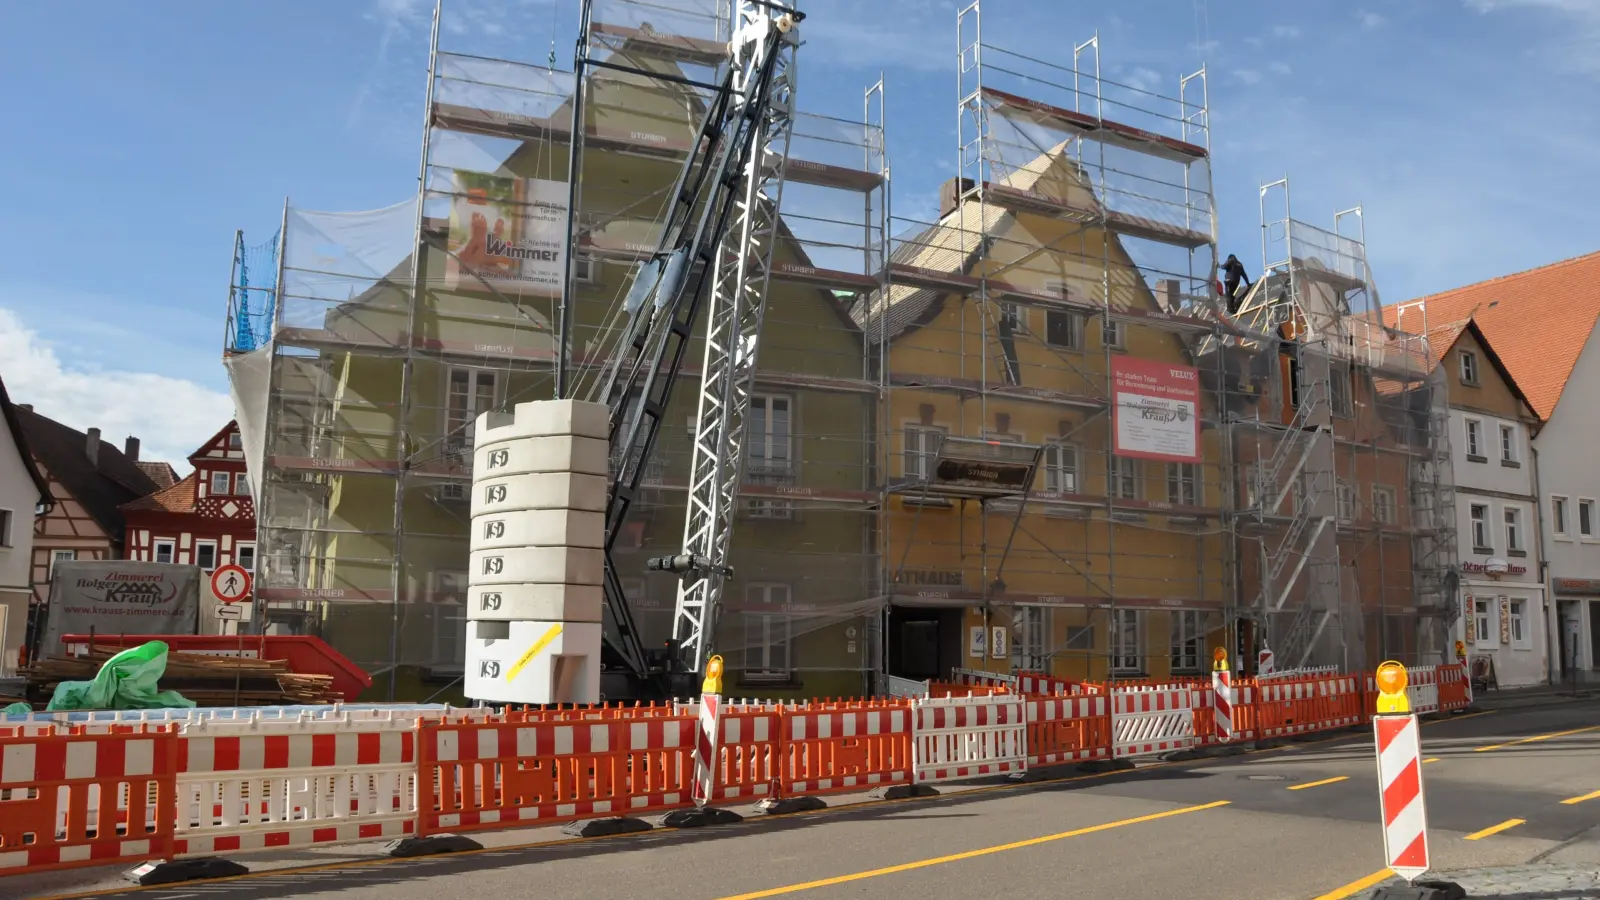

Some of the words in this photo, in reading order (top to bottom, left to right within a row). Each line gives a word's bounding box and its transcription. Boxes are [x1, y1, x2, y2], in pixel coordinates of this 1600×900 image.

[486, 232, 559, 262] Wimmer
[1169, 369, 1194, 380] VELUX
[489, 449, 509, 469] KSD
[487, 484, 507, 504] KSD
[485, 520, 505, 540] KSD
[484, 556, 504, 575] KSD
[1507, 562, 1527, 574] Haus
[76, 578, 119, 591] Holger
[104, 572, 165, 582] Zimmerei
[482, 592, 502, 611] KSD
[480, 660, 500, 679] KSD
